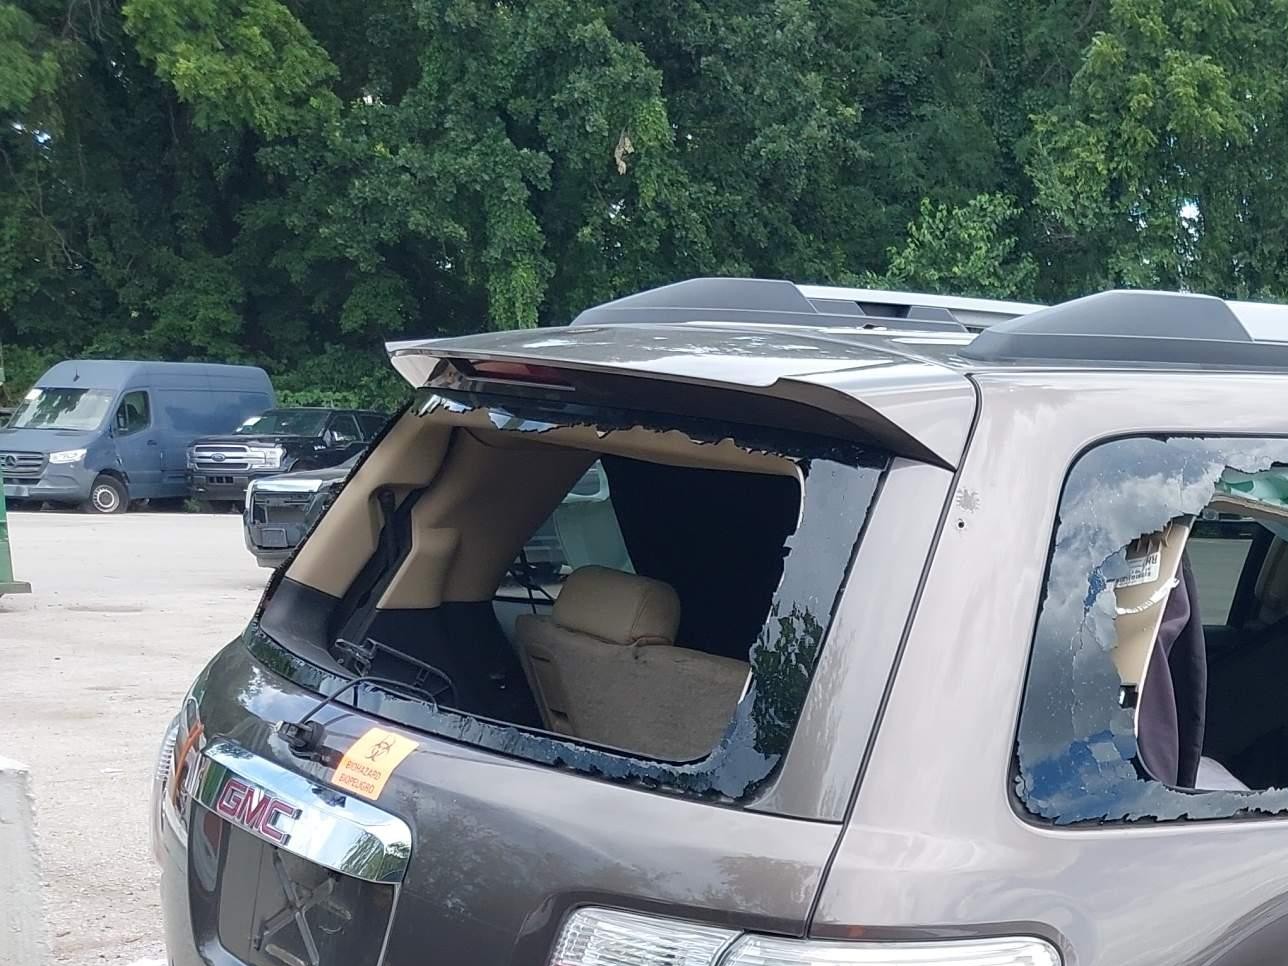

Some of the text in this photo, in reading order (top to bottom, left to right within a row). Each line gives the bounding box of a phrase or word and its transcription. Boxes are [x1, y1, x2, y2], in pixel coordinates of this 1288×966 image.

[345, 759, 382, 781] BIOHAZARD
[338, 773, 375, 794] BIOPELIGRO
[216, 776, 303, 846] GMC
